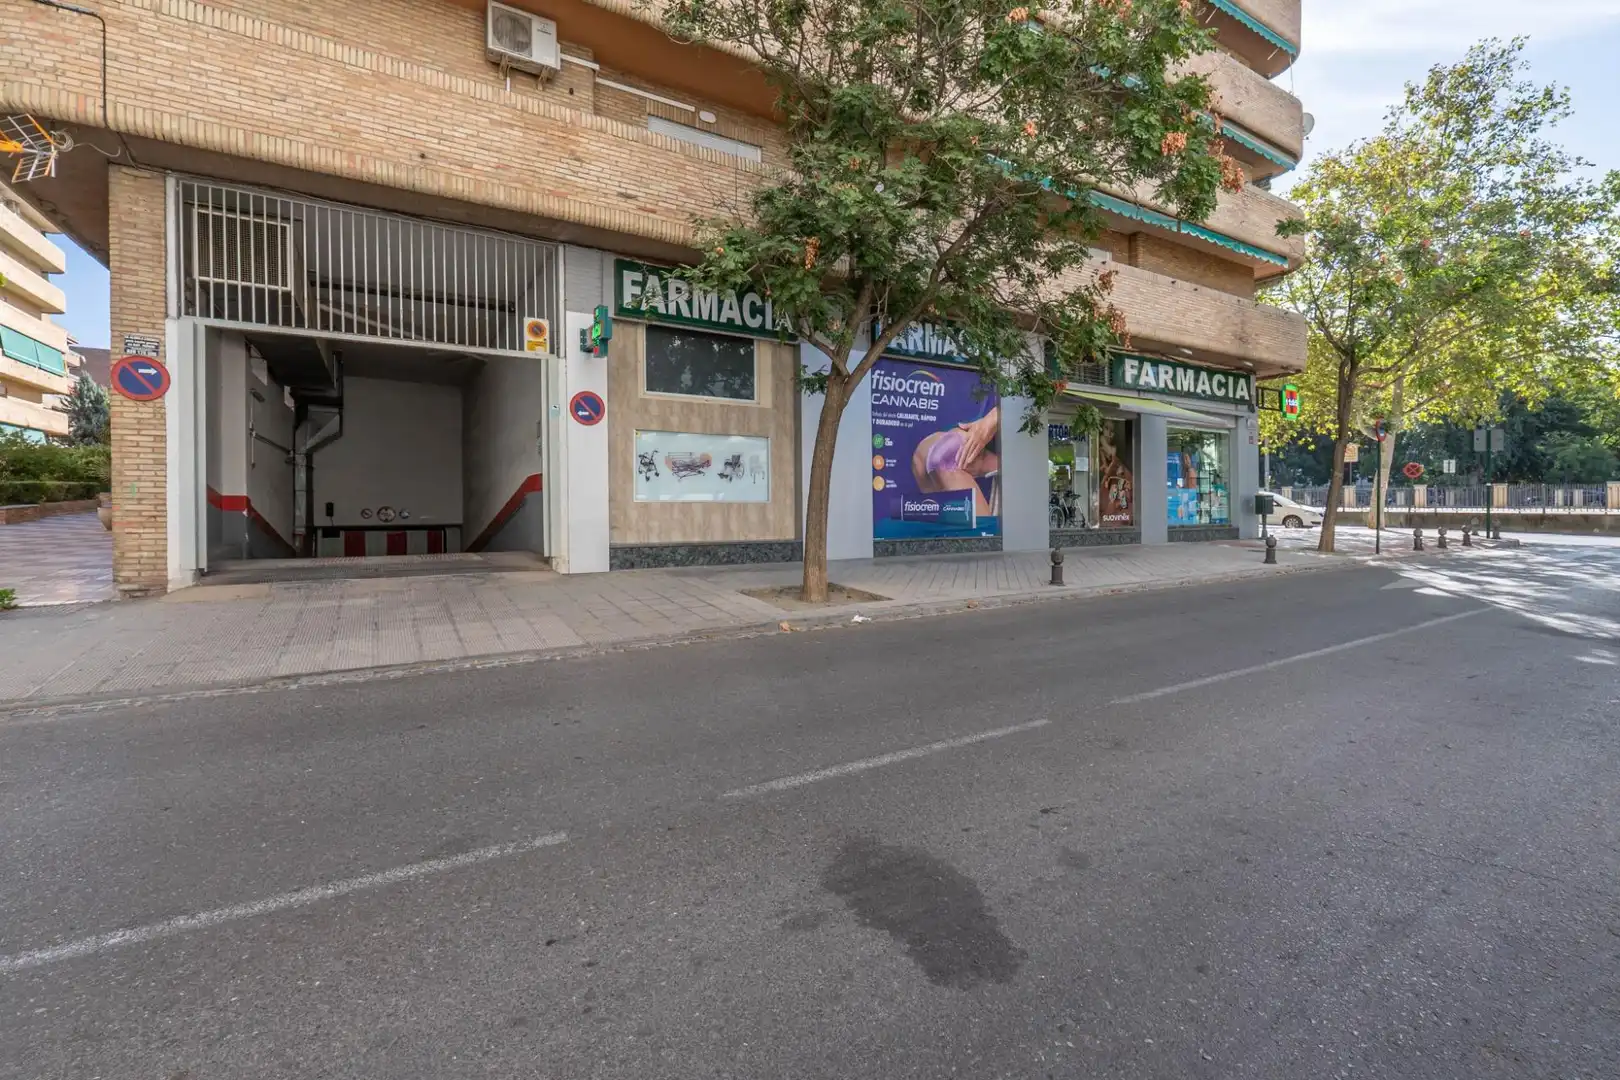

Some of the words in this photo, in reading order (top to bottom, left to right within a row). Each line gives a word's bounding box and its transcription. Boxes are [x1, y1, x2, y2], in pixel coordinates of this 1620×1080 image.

[871, 369, 946, 397] fisiocrem
[1124, 358, 1250, 401] FARMACIA
[871, 393, 940, 411] CANNABIS
[904, 501, 940, 512] fisiocrem
